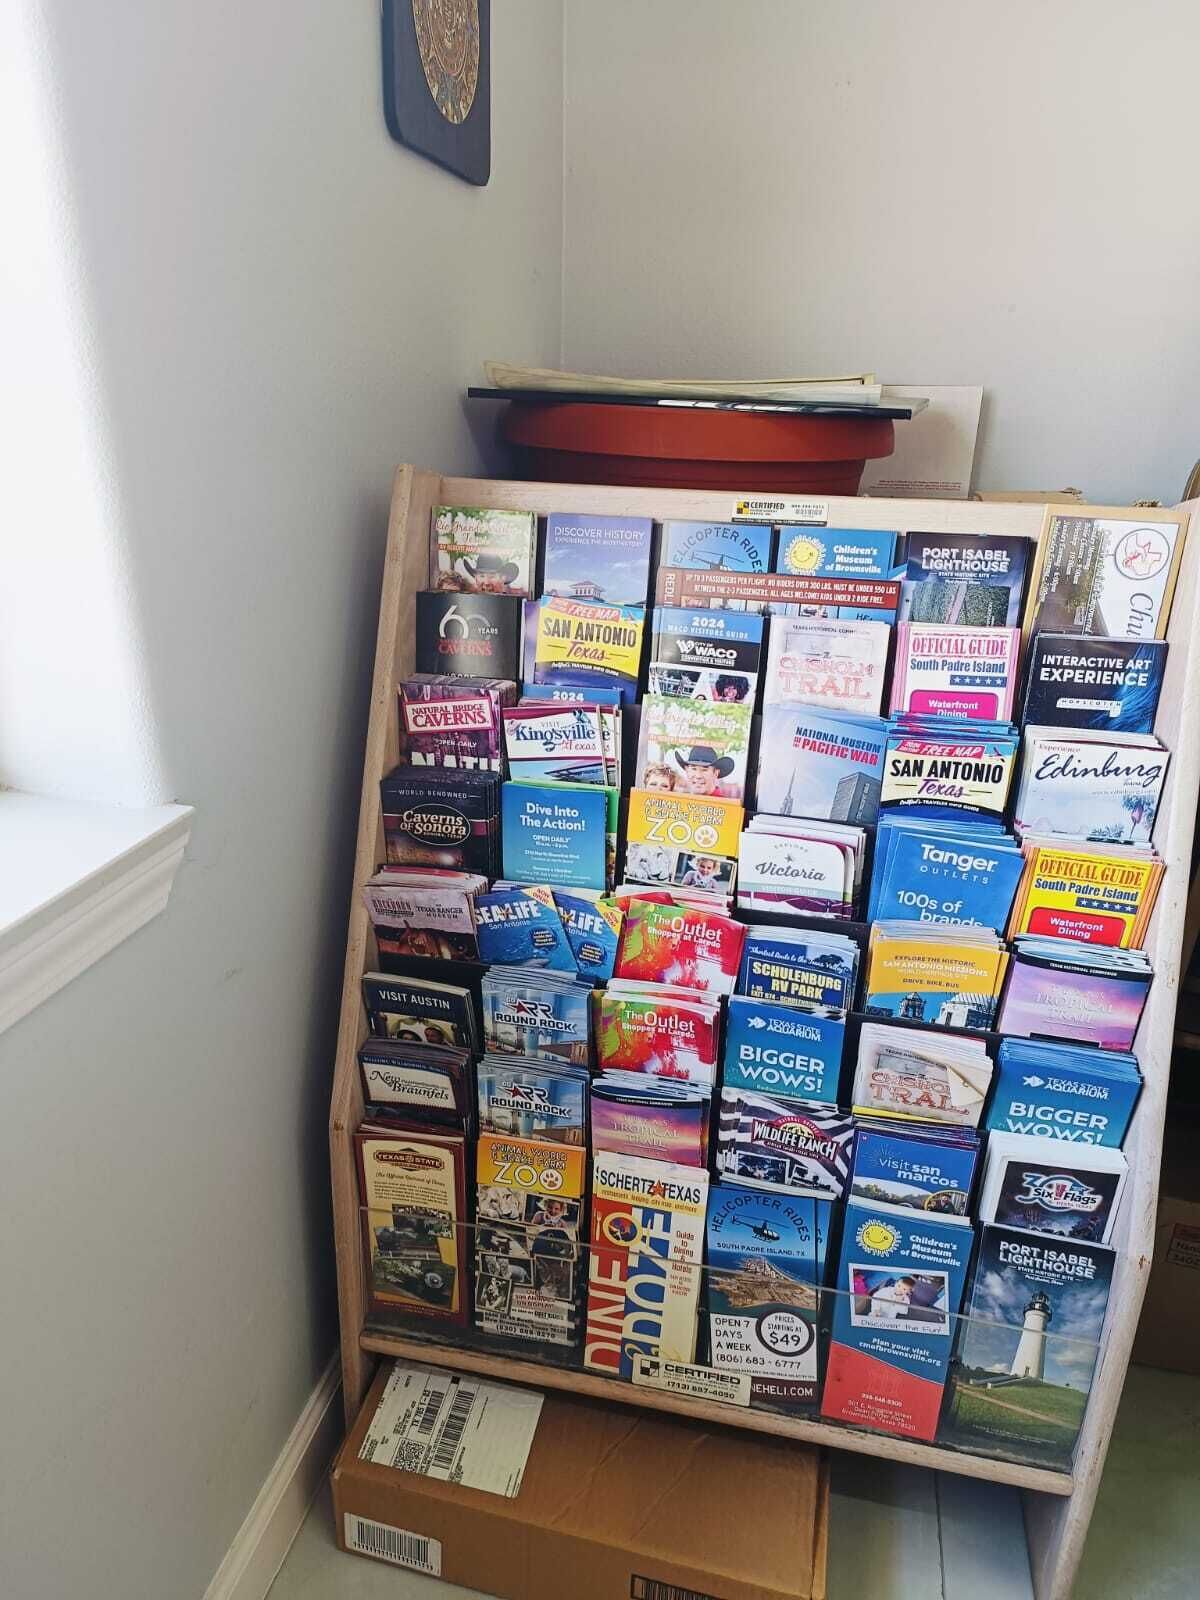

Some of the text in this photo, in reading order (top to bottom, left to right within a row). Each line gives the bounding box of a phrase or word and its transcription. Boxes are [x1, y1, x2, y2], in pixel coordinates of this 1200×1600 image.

[750, 502, 785, 510] CERTIFIED
[554, 526, 645, 541] DISCOVER HISTORY
[833, 545, 878, 555] Children's
[922, 547, 1010, 562] PORT ISABEL
[835, 555, 873, 564] Museum
[921, 559, 1009, 573] LIGHTHOUSE
[835, 564, 881, 574] Brownsville
[796, 580, 808, 588] OVER
[833, 583, 847, 591] MUST
[856, 584, 873, 593] UNDER
[567, 604, 619, 621] FREE MAP
[478, 627, 498, 635] YEARS
[692, 617, 725, 629] 2024
[543, 617, 636, 648] SAN ANTONIO
[726, 631, 749, 639] GUIDE
[566, 641, 611, 661] Texas
[695, 646, 738, 659] WACO
[912, 637, 1007, 656] OFFICIAL GUIDE
[910, 658, 1005, 674] South Padre Island
[1042, 654, 1152, 671] INTERACTIVE ART
[779, 671, 873, 699] TRAIL
[1040, 668, 1148, 687] EXPERIENCE
[553, 690, 584, 702] 2024
[928, 699, 978, 710] Waterfront
[412, 703, 485, 715] NATURAL BRIDGE
[412, 710, 487, 728] CAVERNS
[515, 722, 596, 752] Kingsville
[796, 726, 839, 744] NATIONAL
[840, 736, 881, 754] MUSEUM
[801, 738, 849, 759] PACIFIC
[850, 749, 879, 766] WAR
[920, 743, 982, 758] FREE MAP
[890, 759, 1003, 784] SAN ANTONIO
[1035, 751, 1163, 788] Edinburg
[399, 789, 468, 799] WORLD RENOWNED
[917, 778, 969, 798] Texas
[526, 802, 579, 817] Dive Into
[645, 798, 726, 816] ANIMAL WORLD
[402, 811, 463, 826] Caverns
[520, 814, 586, 831] The Action!
[415, 821, 467, 836] Sonora
[532, 834, 550, 842] OPEN
[920, 843, 997, 873] Tanger
[755, 861, 825, 882] Victoria
[920, 865, 989, 885] OUTLETS
[1040, 860, 1143, 887] OFFICIAL GUIDE
[1035, 877, 1139, 902] South Padre Island
[897, 890, 964, 913] 100s of
[652, 912, 723, 943] The Outlet
[1050, 917, 1104, 932] Waterfront
[1057, 926, 1091, 939] Dining
[683, 933, 721, 949] at Laredo
[901, 961, 942, 970] ANTONIO
[944, 965, 988, 977] MISSIONS
[942, 958, 976, 967] HISTORIC
[752, 961, 842, 991] SCHULENBURG
[771, 978, 824, 1001] RV PARK
[379, 990, 450, 1010] VISIT AUSTIN
[496, 1013, 573, 1032] ROUND ROCK
[625, 1009, 695, 1034] The Outlet
[768, 1018, 821, 1033] TEXAS STATE
[657, 1025, 695, 1039] at Laredo
[767, 1025, 821, 1042] AQUARIUM
[739, 1044, 825, 1076] BIGGER
[370, 1070, 401, 1088] New
[738, 1062, 822, 1093] WOWS!
[1048, 1077, 1109, 1094] TEXAS STATE
[392, 1081, 449, 1100] Braunfels
[1045, 1083, 1109, 1100] AQUARIUM
[491, 1097, 567, 1116] ROUND ROCK
[1009, 1101, 1108, 1130] BIGGER
[753, 1120, 837, 1161] WILDLIFE RANCH
[1007, 1118, 1103, 1146] WOWS!
[491, 1143, 567, 1162] ANIMAL WORLD
[536, 1157, 566, 1170] FARM
[879, 1156, 941, 1177] visit san
[600, 1169, 656, 1195] SCHERTZ
[661, 1182, 702, 1205] TEXAS
[897, 1169, 959, 1189] marcos
[1033, 1187, 1097, 1206] Six Flags
[711, 1195, 782, 1232] HELICOPTER
[786, 1207, 810, 1242] RIDES
[676, 1230, 694, 1240] Guide
[910, 1235, 957, 1249] Children's
[717, 1242, 739, 1250] SOUTH
[740, 1244, 764, 1252] PADRE
[912, 1243, 952, 1257] Museum
[1000, 1241, 1096, 1270] PORT ISABEL
[900, 1249, 961, 1266] of Brownsville
[999, 1252, 1095, 1279] LIGHTHOUSE
[584, 1251, 629, 1374] DINE
[775, 1315, 795, 1324] PRICES
[715, 1317, 750, 1328] OPEN 7
[767, 1322, 794, 1332] STARTING
[715, 1329, 743, 1339] DAYS
[769, 1331, 801, 1347] $49
[716, 1341, 752, 1352] A WEEK
[859, 1341, 942, 1367] cmofbrownsville.org
[872, 1338, 930, 1356] Plan your visit
[716, 1352, 802, 1370] (806) 683 6777
[664, 1363, 741, 1385] CERTIFIED
